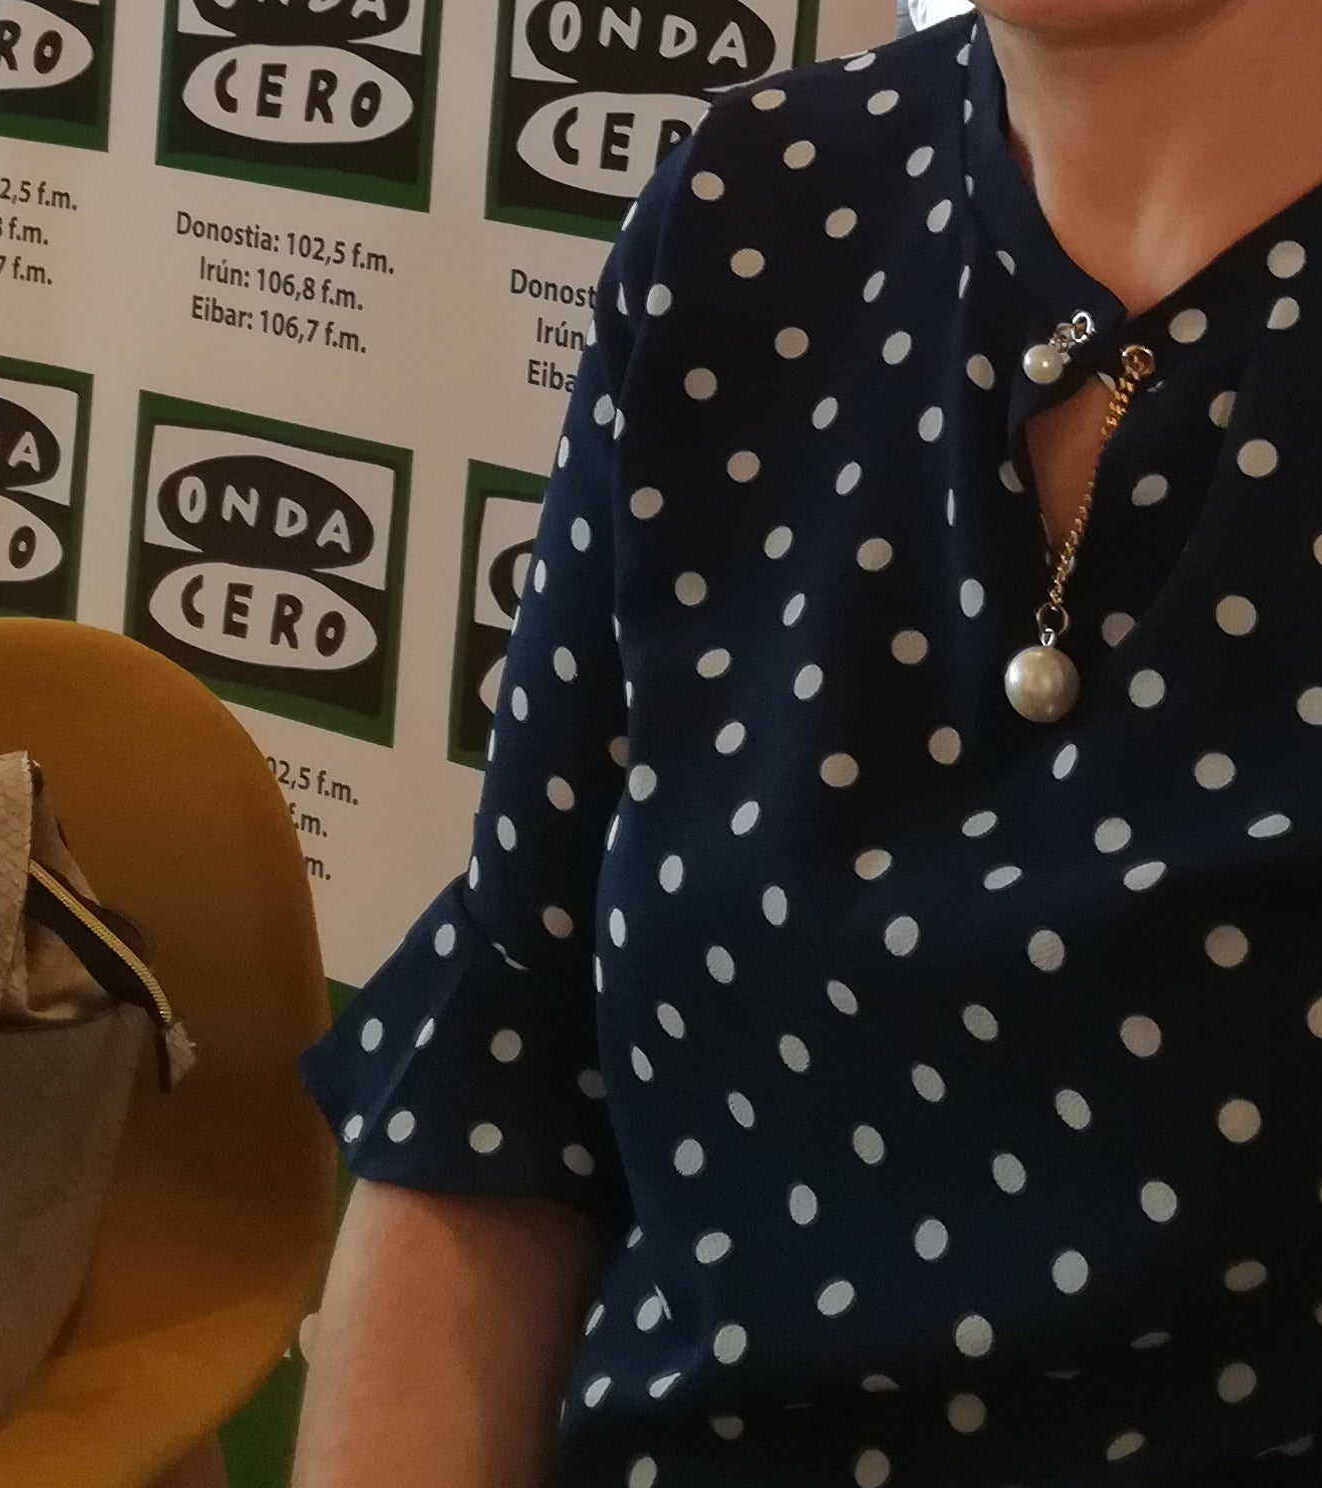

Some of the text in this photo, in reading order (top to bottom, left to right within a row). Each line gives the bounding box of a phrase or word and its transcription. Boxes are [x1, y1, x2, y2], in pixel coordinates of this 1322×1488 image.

[550, 1, 747, 68] ONDA
[215, 59, 381, 127] CERO
[553, 107, 691, 171] CER
[36, 180, 78, 211] f.m.
[8, 216, 49, 246] f.m.
[176, 210, 394, 275] Donostia: 102,5 f.m.
[11, 255, 53, 286] f.m.
[199, 255, 363, 311] Irún: 106,8 f.m.
[510, 268, 596, 310] Donost
[191, 294, 367, 354] Eibar: 106,7 f.m.
[536, 317, 588, 352] Irún
[527, 358, 575, 394] Eiba
[178, 476, 350, 552] ONDA
[182, 575, 346, 656] CERO
[316, 769, 359, 806] f.m.
